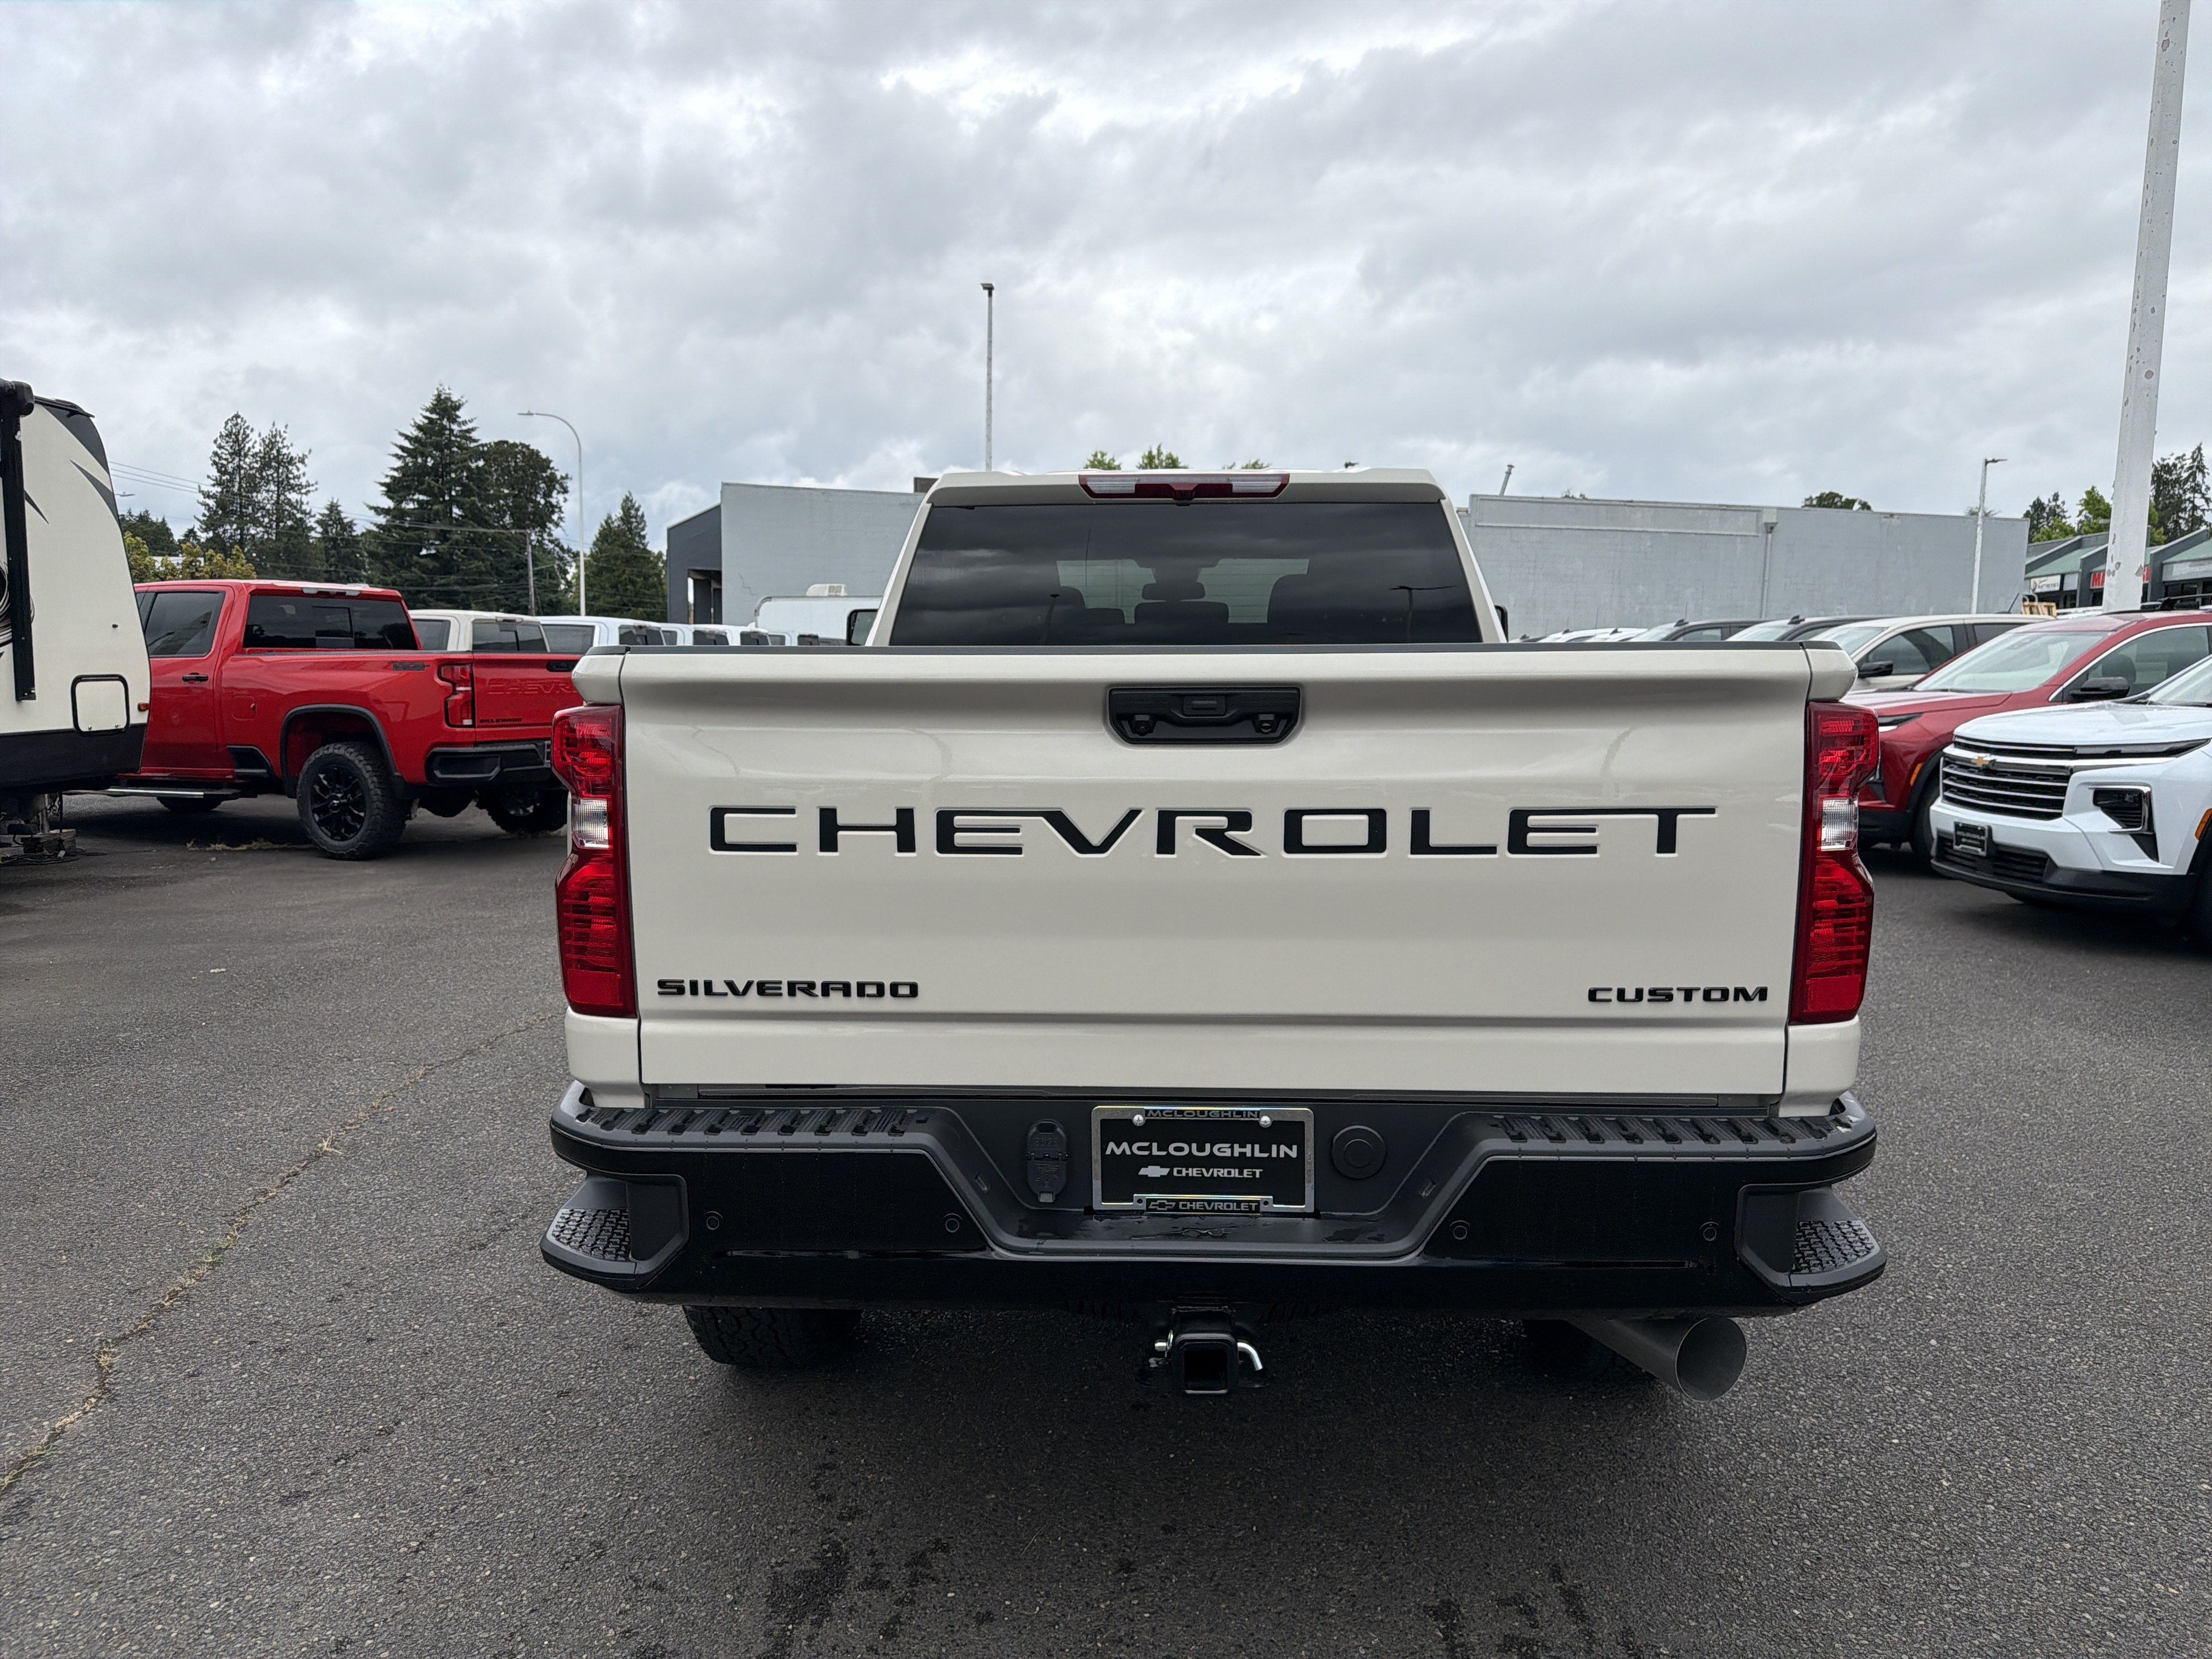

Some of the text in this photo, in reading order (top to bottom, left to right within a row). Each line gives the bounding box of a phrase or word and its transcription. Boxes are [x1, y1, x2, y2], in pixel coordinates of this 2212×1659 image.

[710, 808, 1716, 856] CHEVROLET
[657, 979, 918, 998] SILVERADO
[1588, 986, 1768, 1002] CUSTOM
[1147, 1110, 1258, 1118] MCLOUGHLIN
[1105, 1142, 1297, 1158] MCLOUGHLIN
[1173, 1167, 1263, 1178] CHEVROLET
[1179, 1201, 1258, 1211] CHEVROLET
